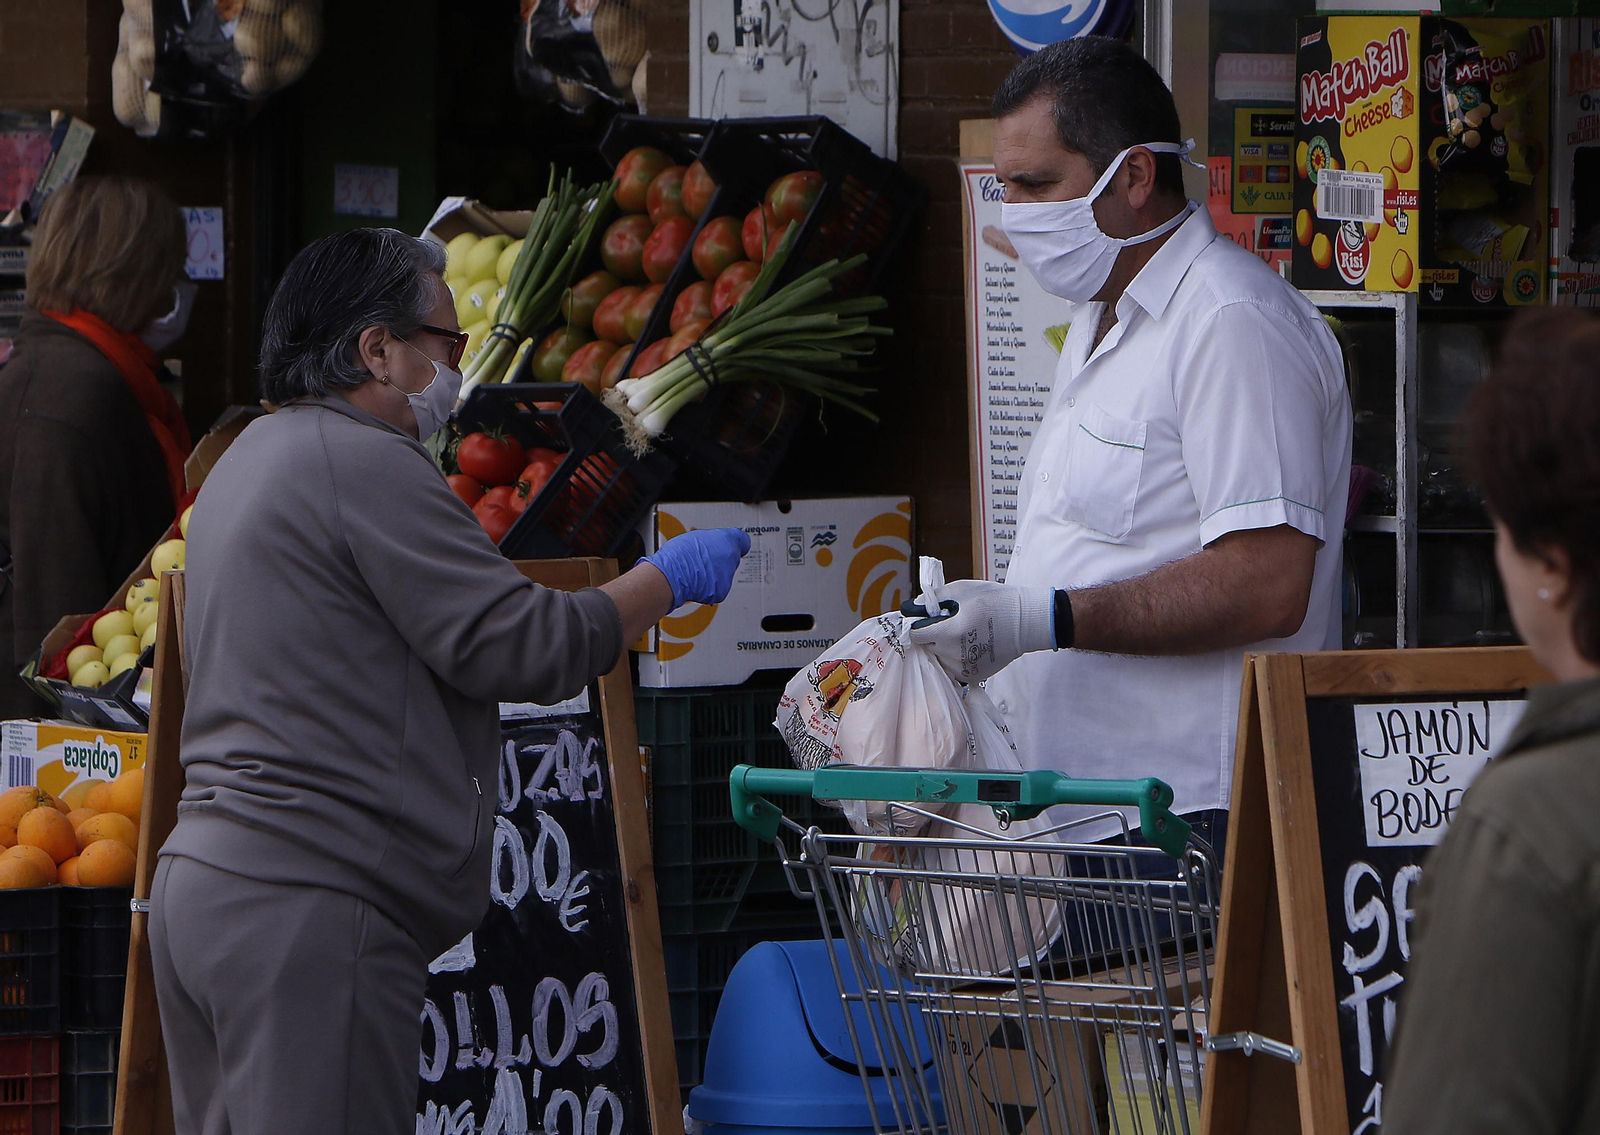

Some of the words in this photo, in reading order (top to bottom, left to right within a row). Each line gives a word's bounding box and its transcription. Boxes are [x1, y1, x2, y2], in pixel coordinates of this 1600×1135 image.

[1301, 60, 1366, 116] Match
[1365, 30, 1406, 87] Ball
[1344, 102, 1391, 137] Cheese
[1264, 192, 1286, 200] CAJA
[1340, 252, 1364, 271] Risi
[736, 640, 781, 650] CANARIAS
[783, 640, 796, 650] DE
[797, 638, 839, 651] LÁTANOS
[1361, 701, 1490, 759] JAMÓN
[64, 742, 118, 778] Coplaca
[128, 746, 138, 760] 17
[1408, 754, 1450, 786] DE
